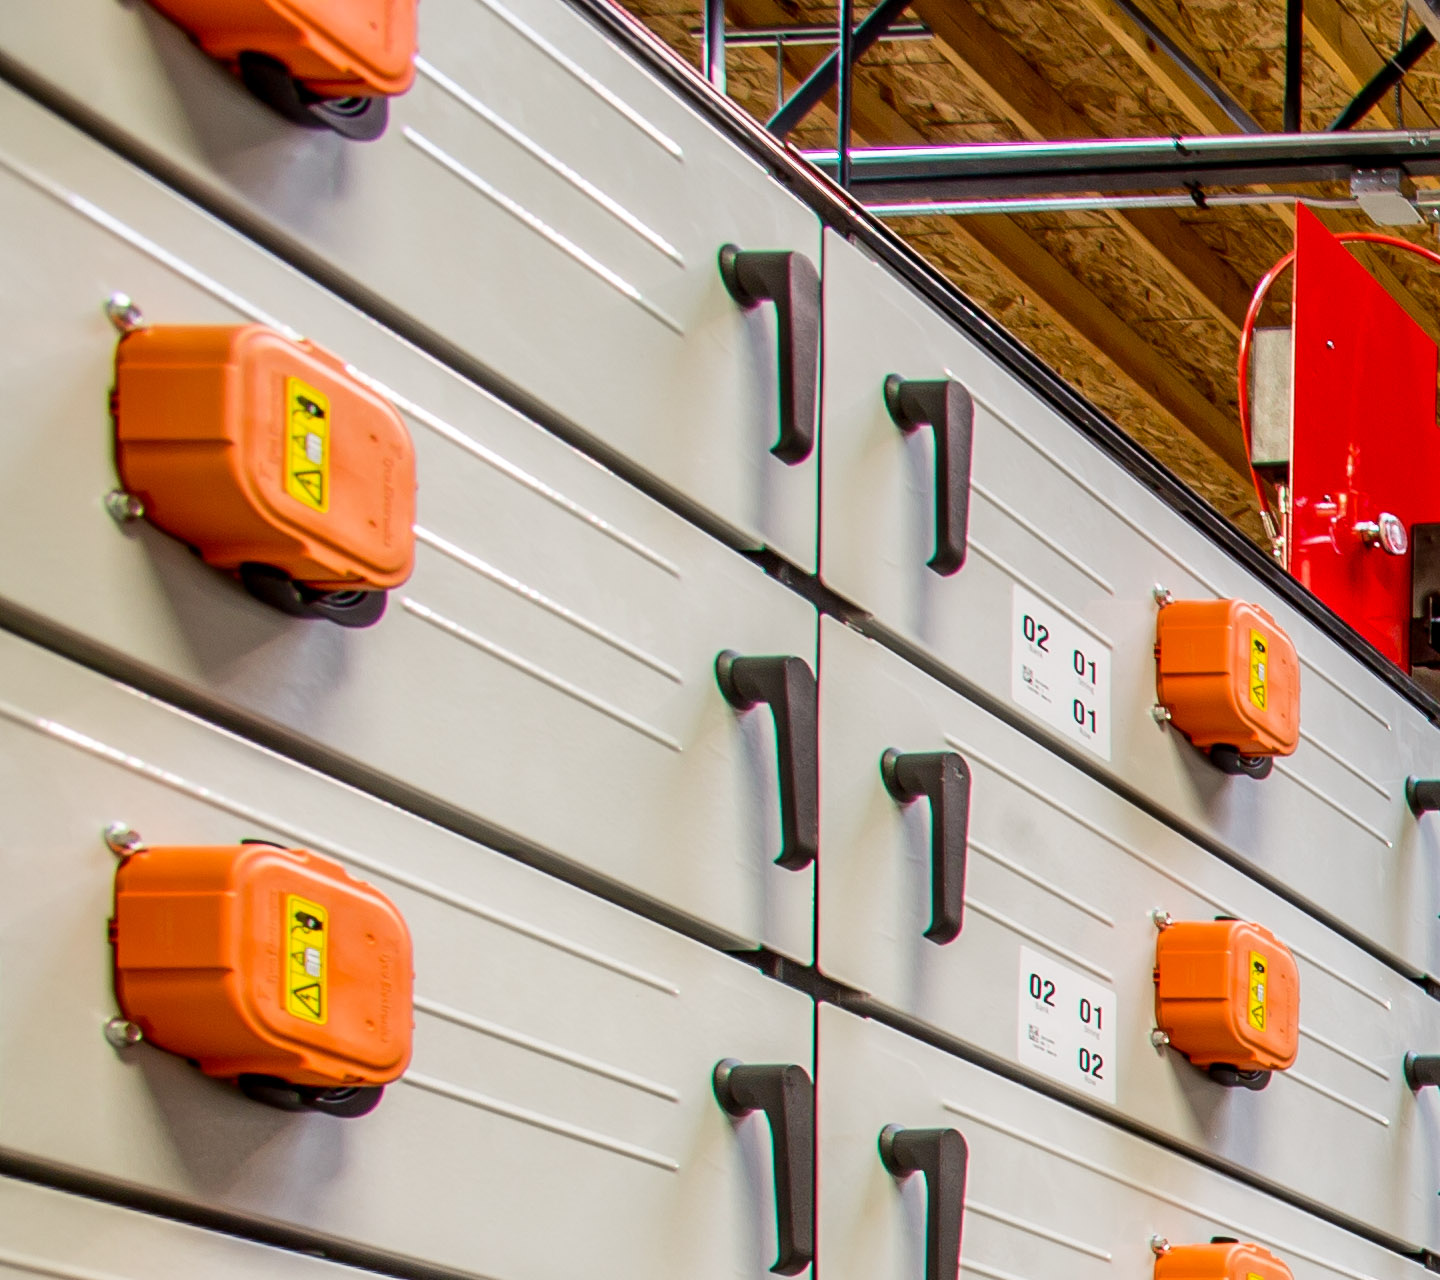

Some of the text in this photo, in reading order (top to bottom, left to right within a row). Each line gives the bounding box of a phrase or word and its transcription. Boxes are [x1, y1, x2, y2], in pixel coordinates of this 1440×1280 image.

[1023, 614, 1049, 653] 02
[1073, 649, 1096, 685] 01
[1073, 698, 1096, 734] 01
[1029, 973, 1056, 1007] 02
[1079, 998, 1102, 1030] 01
[1079, 1047, 1103, 1080] 02
